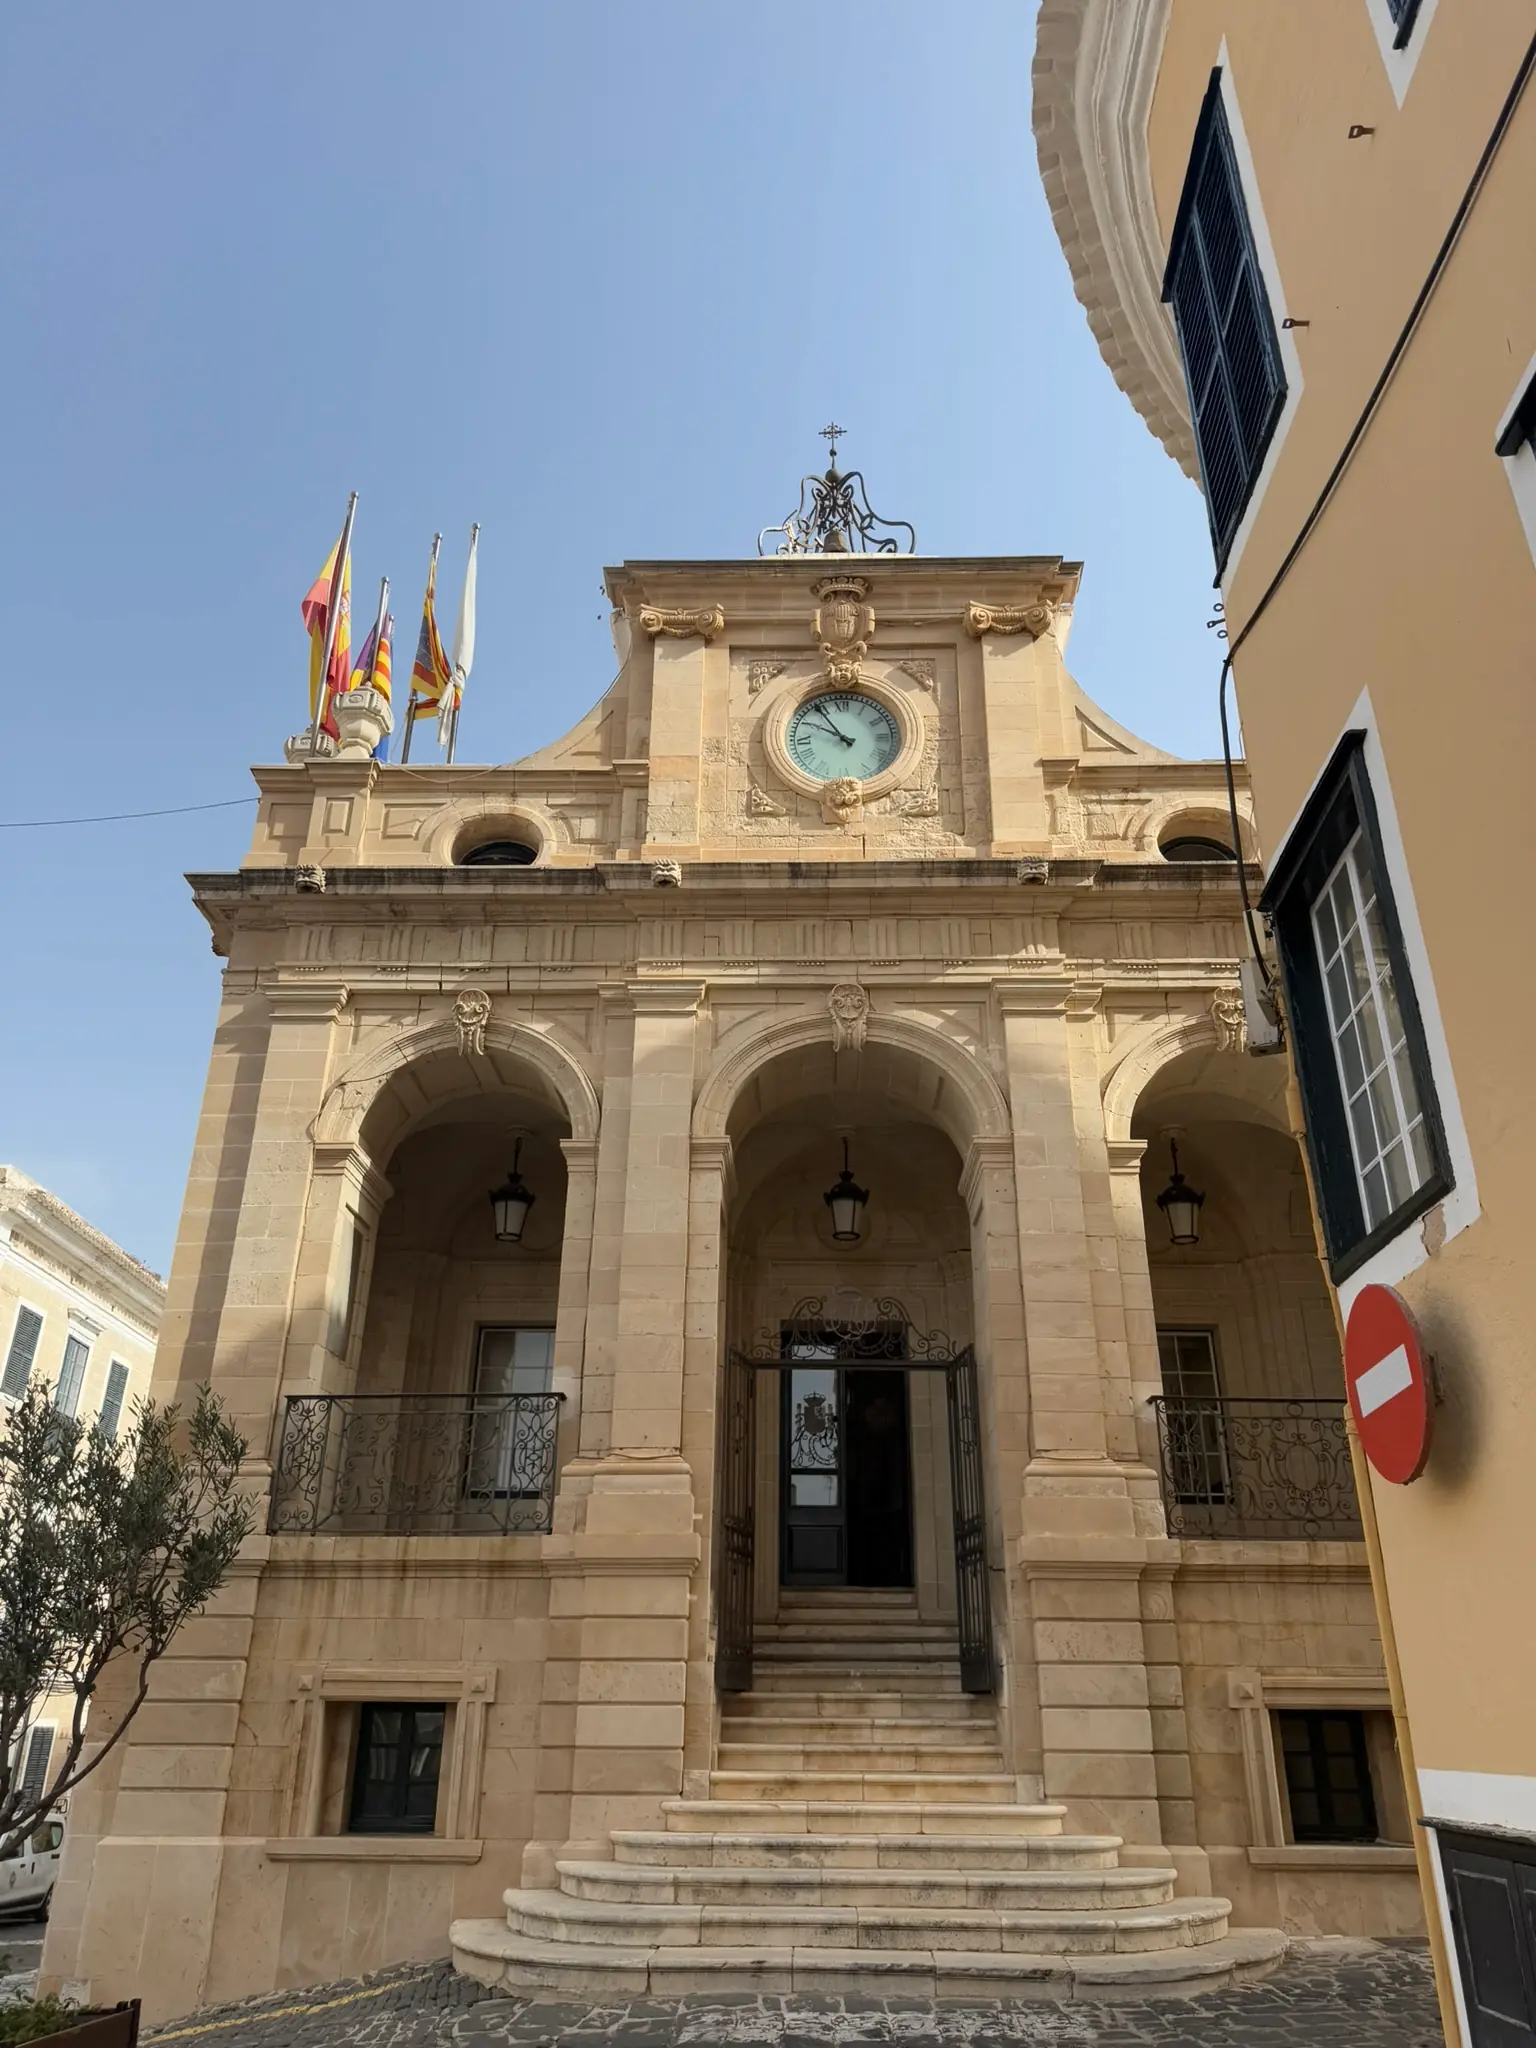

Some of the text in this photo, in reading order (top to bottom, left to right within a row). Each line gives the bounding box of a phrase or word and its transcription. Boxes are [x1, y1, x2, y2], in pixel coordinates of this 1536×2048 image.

[834, 701, 850, 713] XII
[869, 716, 884, 728] II
[875, 733, 890, 743] III
